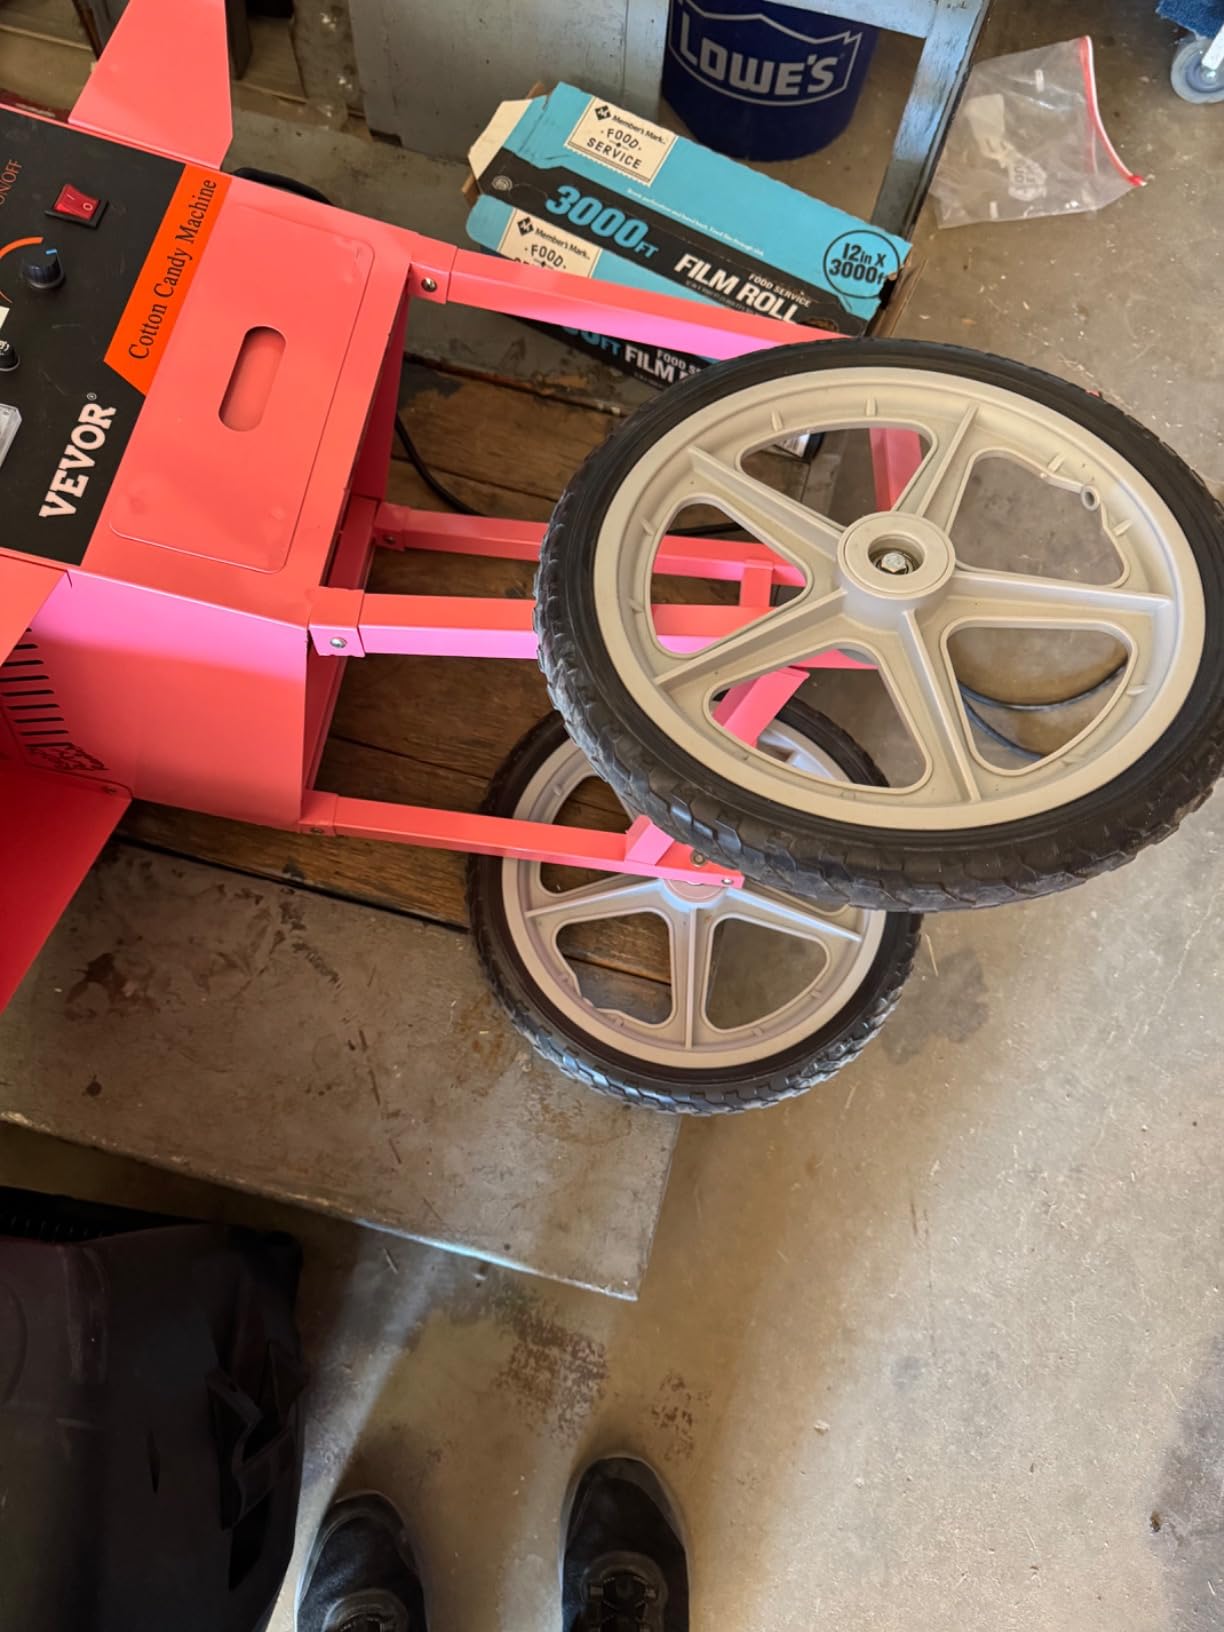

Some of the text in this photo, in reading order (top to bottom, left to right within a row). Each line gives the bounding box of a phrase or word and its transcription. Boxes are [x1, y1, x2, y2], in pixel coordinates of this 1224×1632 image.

[680, 11, 838, 95] LOWE'S
[606, 128, 639, 149] FOOD
[612, 115, 663, 144] Member's Mark
[587, 137, 642, 169] SERVICE
[531, 244, 564, 267] FOOD
[535, 228, 587, 257] Member's Mark
[842, 242, 872, 264] 12in
[128, 179, 217, 360] Cotton Candy Machine
[829, 258, 885, 285] 3000f
[674, 253, 740, 295] FILM
[736, 282, 798, 325] ROLL
[748, 273, 773, 290] FOOD
[774, 285, 811, 308] SERVICE
[624, 344, 675, 383] FILM
[656, 348, 686, 370] FOOD
[39, 402, 117, 520] VEVOR
